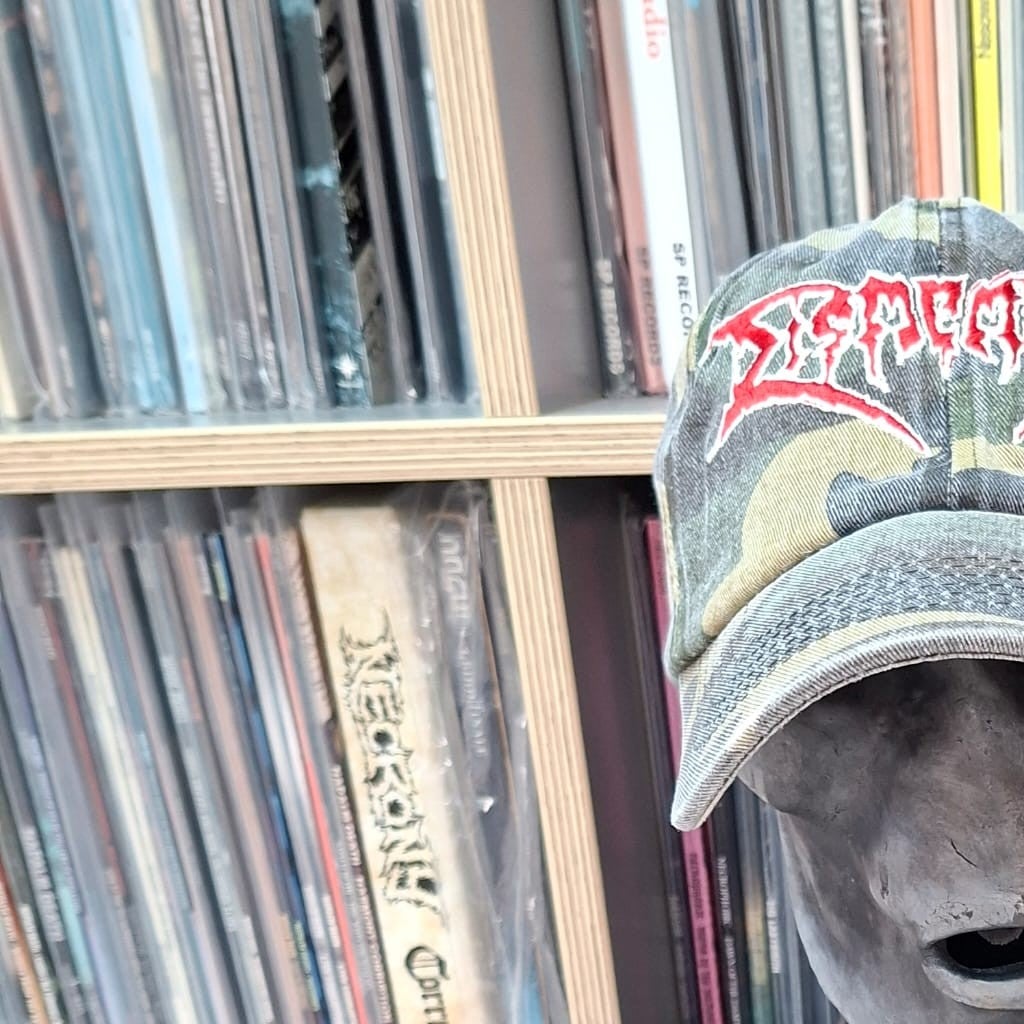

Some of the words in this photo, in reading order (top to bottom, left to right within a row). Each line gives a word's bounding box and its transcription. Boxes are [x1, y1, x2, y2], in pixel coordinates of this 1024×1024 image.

[596, 258, 614, 285] SP
[672, 243, 686, 266] SP
[675, 275, 693, 336] RECO
[600, 287, 625, 375] RECORDS
